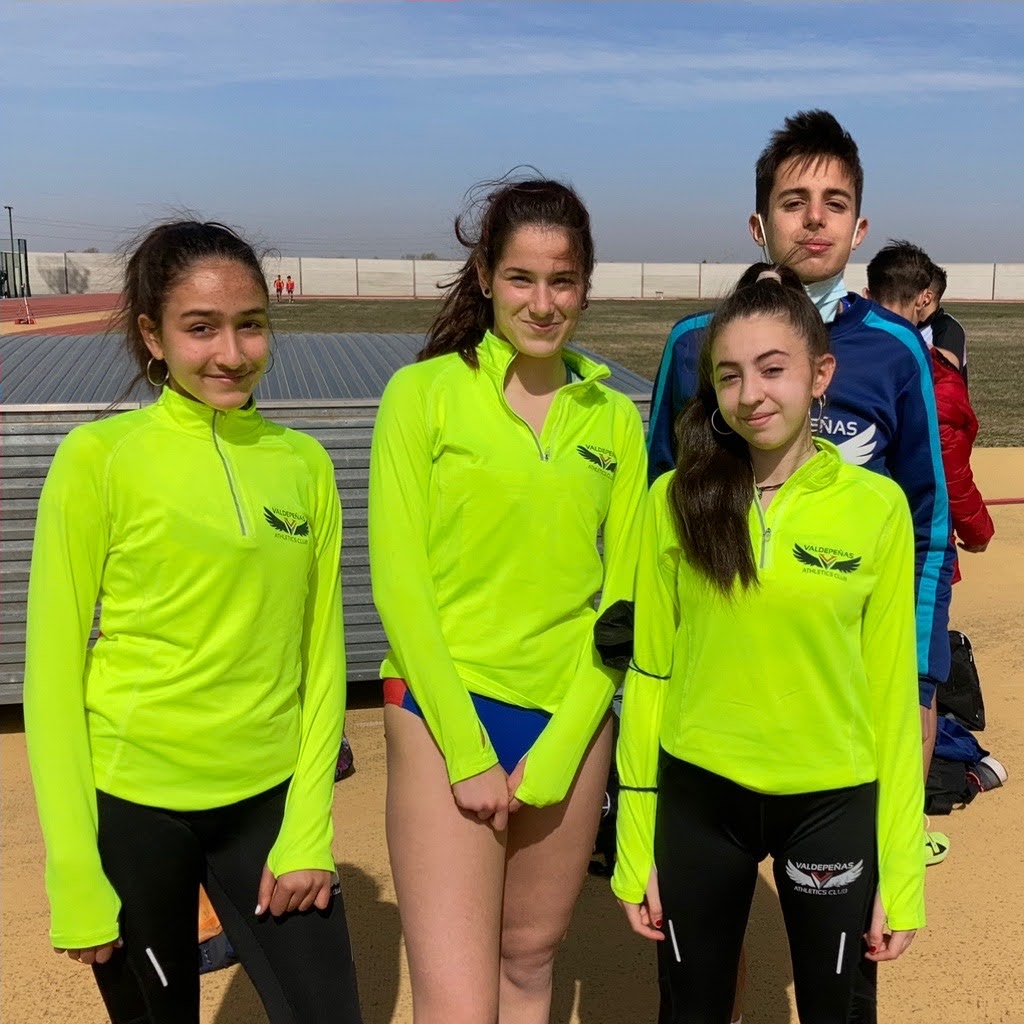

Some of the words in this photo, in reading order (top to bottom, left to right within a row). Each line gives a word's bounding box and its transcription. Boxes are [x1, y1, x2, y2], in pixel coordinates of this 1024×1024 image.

[804, 544, 854, 559] VALDEPEÑAS
[796, 862, 854, 871] VALDEPEÑAS
[794, 886, 828, 896] ATHLETICS
[828, 888, 848, 896] CLUB
